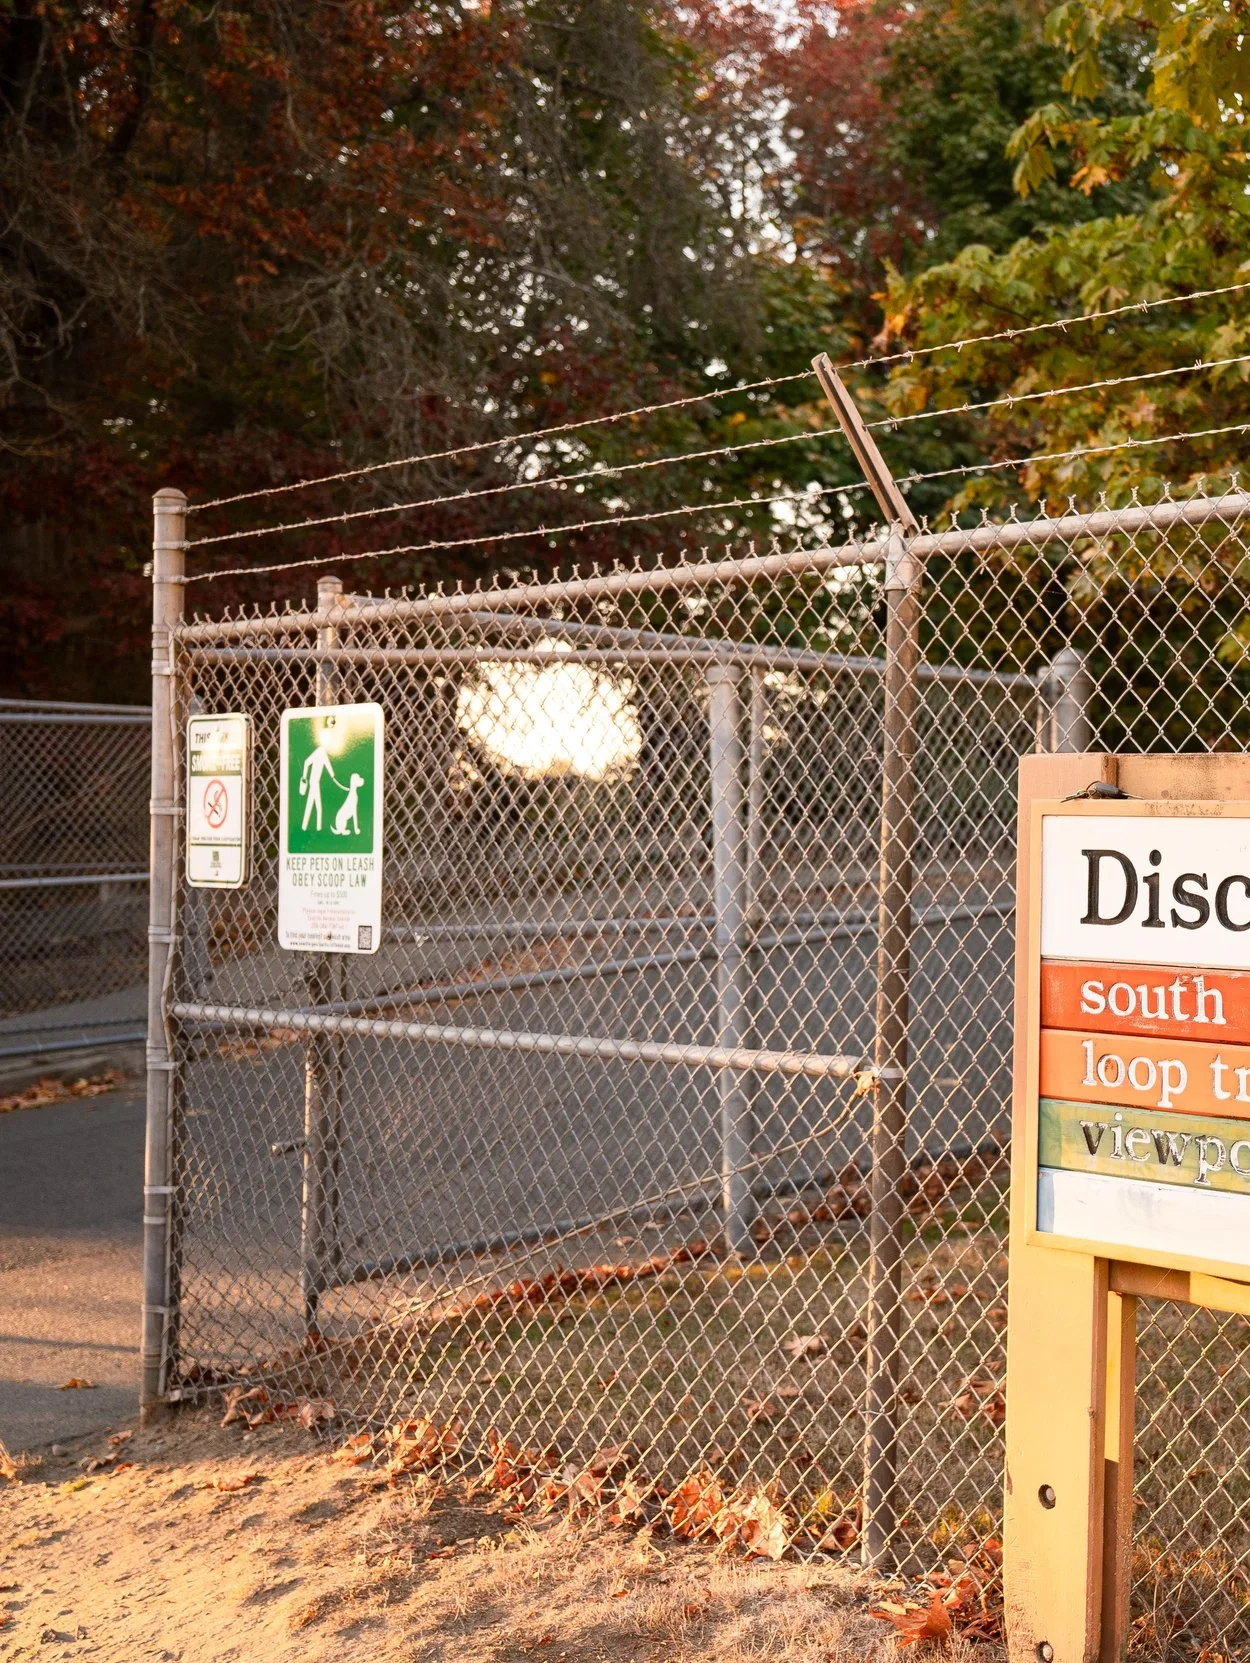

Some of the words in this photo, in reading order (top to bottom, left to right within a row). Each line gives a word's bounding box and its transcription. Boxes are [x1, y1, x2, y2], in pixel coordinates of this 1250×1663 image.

[286, 857, 306, 871] KEEP
[310, 857, 329, 871] PETS
[333, 857, 343, 871] ON
[347, 857, 374, 871] LEASH
[292, 873, 315, 887] OBEY
[317, 873, 345, 887] SCOOP
[349, 873, 366, 887] LAW
[1080, 975, 1226, 1024] south
[1080, 1040, 1188, 1108] loop
